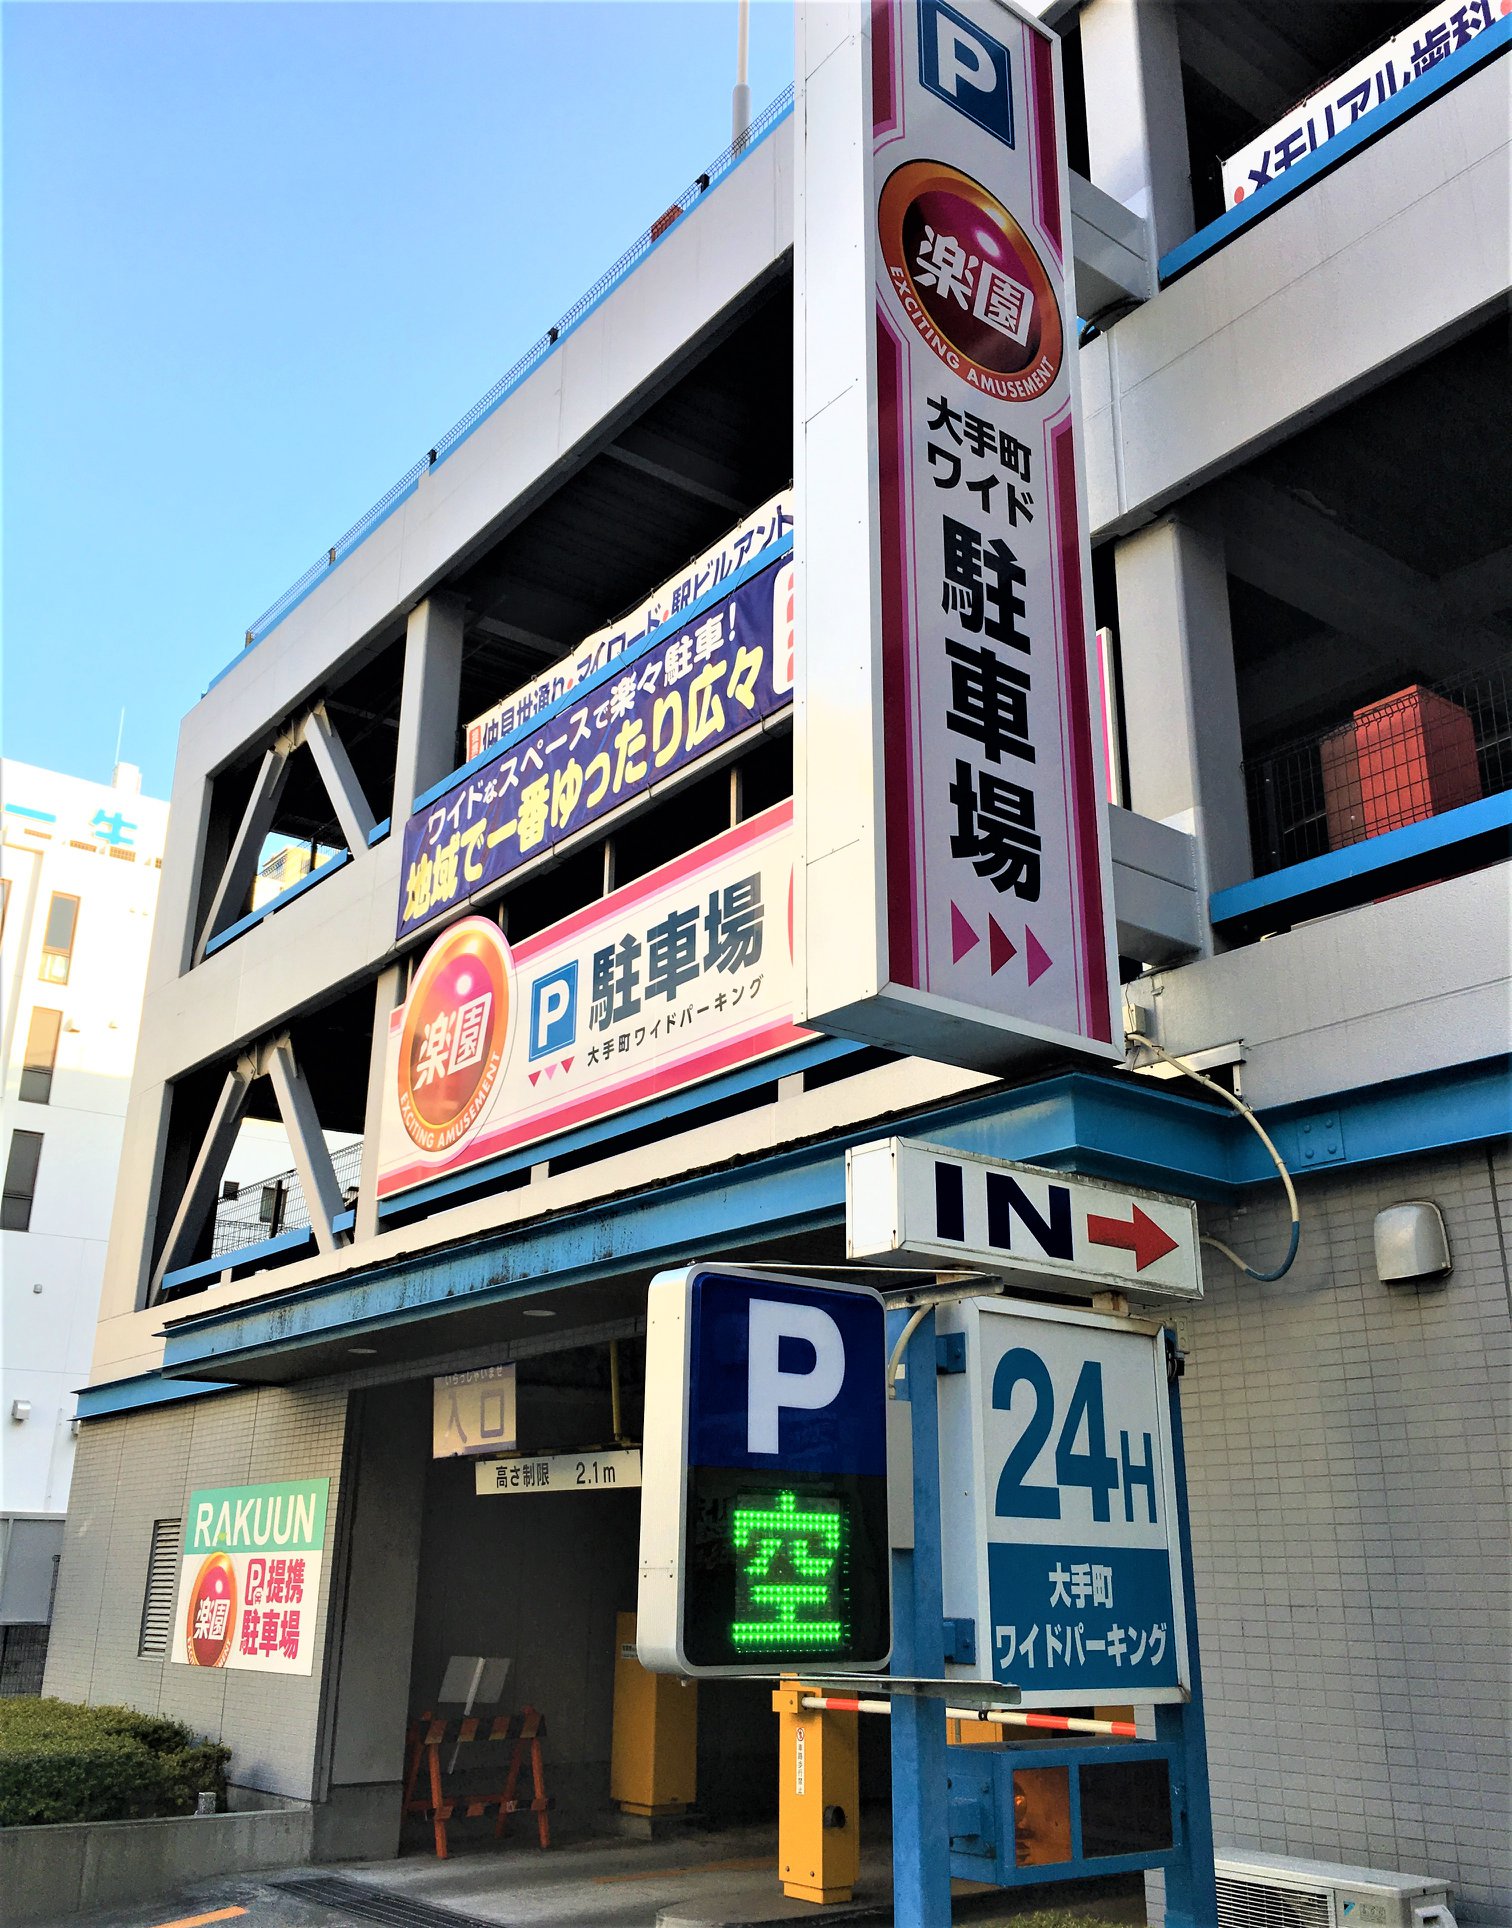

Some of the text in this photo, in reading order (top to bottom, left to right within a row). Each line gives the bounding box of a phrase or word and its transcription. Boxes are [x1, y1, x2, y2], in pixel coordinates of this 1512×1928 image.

[936, 10, 997, 97] P
[913, 225, 1034, 347] 楽園
[890, 265, 1055, 398] EXCITING AMUSEMENT
[926, 395, 1032, 483] 大手町
[926, 441, 1034, 527] ワイド
[941, 514, 1042, 902] 駐車場
[403, 645, 763, 922] 地域で一番ゆったり広々
[588, 872, 765, 1031] 駐車場
[413, 991, 493, 1090] 楽園
[537, 978, 570, 1048] P
[586, 973, 764, 1067] 大手町ワイドパーキング
[400, 1050, 501, 1148] EXCITING AMUSEMENT
[934, 1161, 1074, 1260] IN
[445, 1365, 503, 1385] いらっしゃいませ
[445, 1388, 505, 1443] 入口
[747, 1298, 845, 1454] P
[496, 1461, 616, 1488] 高さ制限 2.1m
[992, 1347, 1157, 1523] 24H
[194, 1493, 316, 1547] RAKUUN
[266, 1559, 305, 1603] 提携
[732, 1489, 841, 1642] 空
[1048, 1562, 1114, 1609] 大手町
[193, 1596, 230, 1640] 楽園
[239, 1609, 300, 1659] 駐車場
[996, 1622, 1168, 1669] ワイドパーキング
